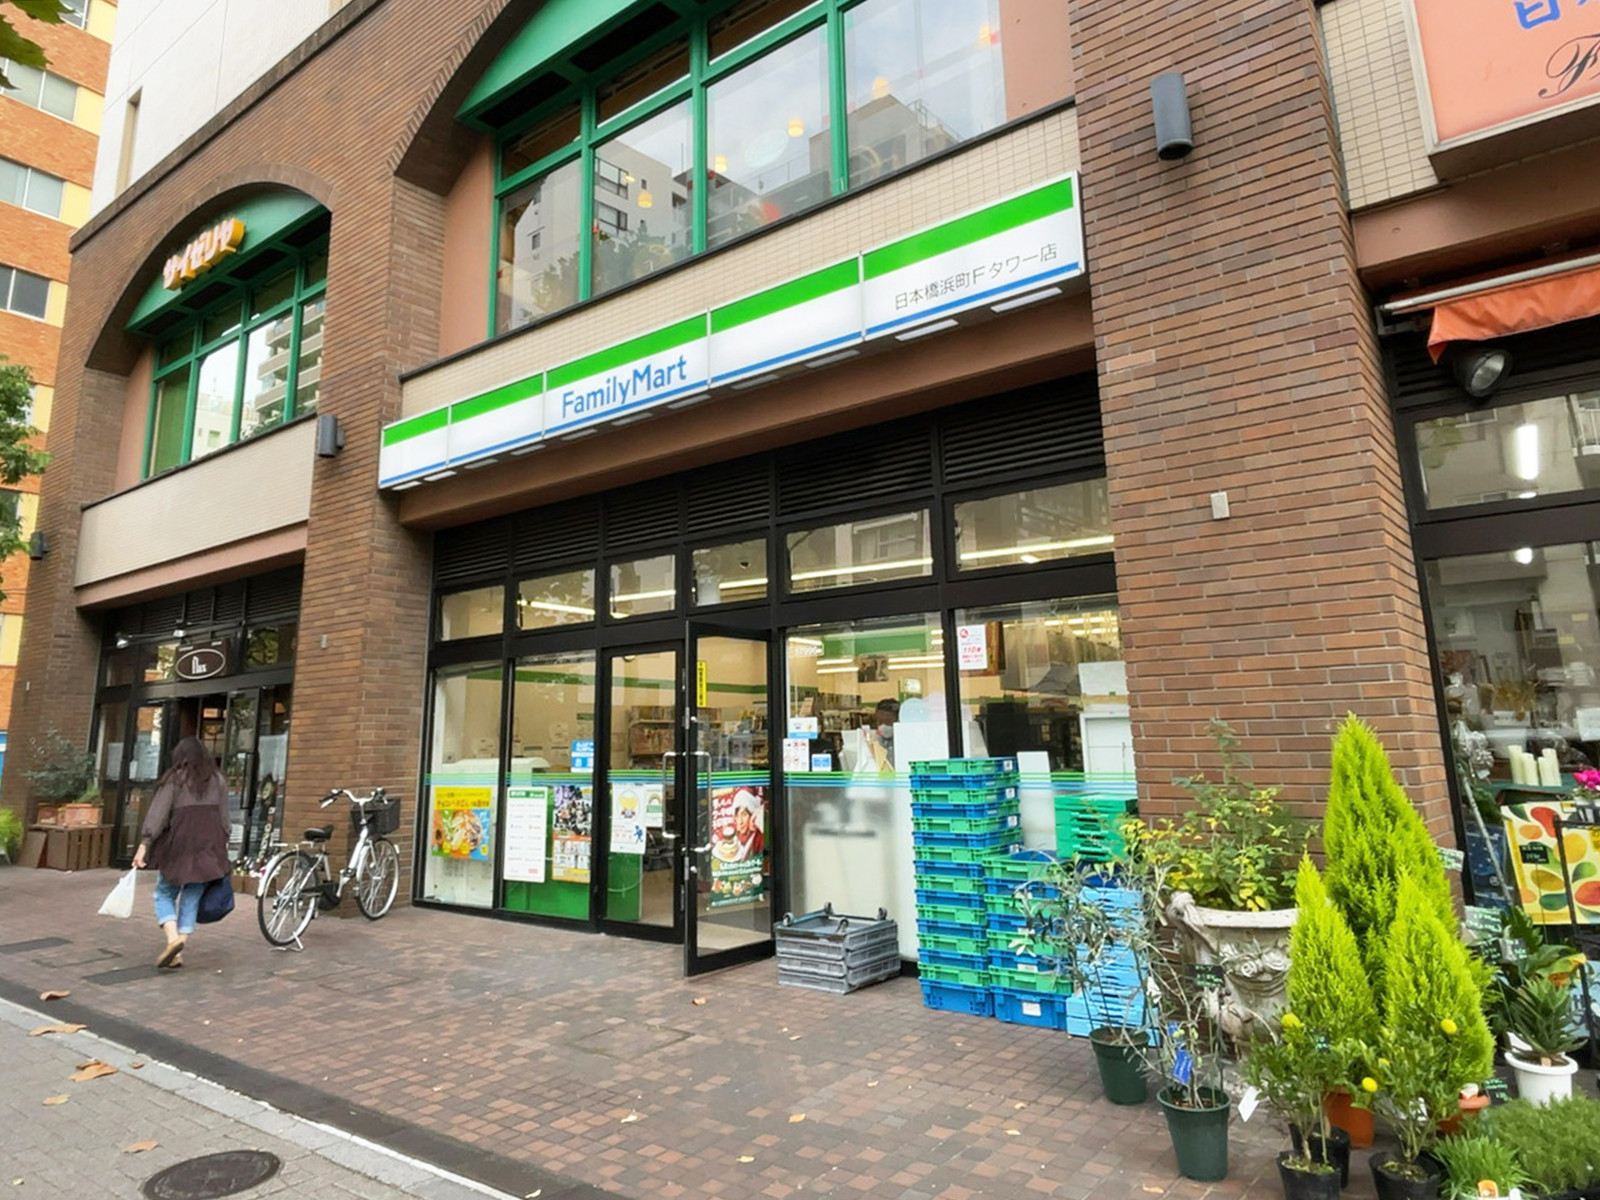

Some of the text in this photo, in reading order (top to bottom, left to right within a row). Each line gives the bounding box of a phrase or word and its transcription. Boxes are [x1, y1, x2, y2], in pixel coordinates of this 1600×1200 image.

[163, 218, 245, 290] サイゼリヤ
[562, 354, 687, 419] FamilyMart
